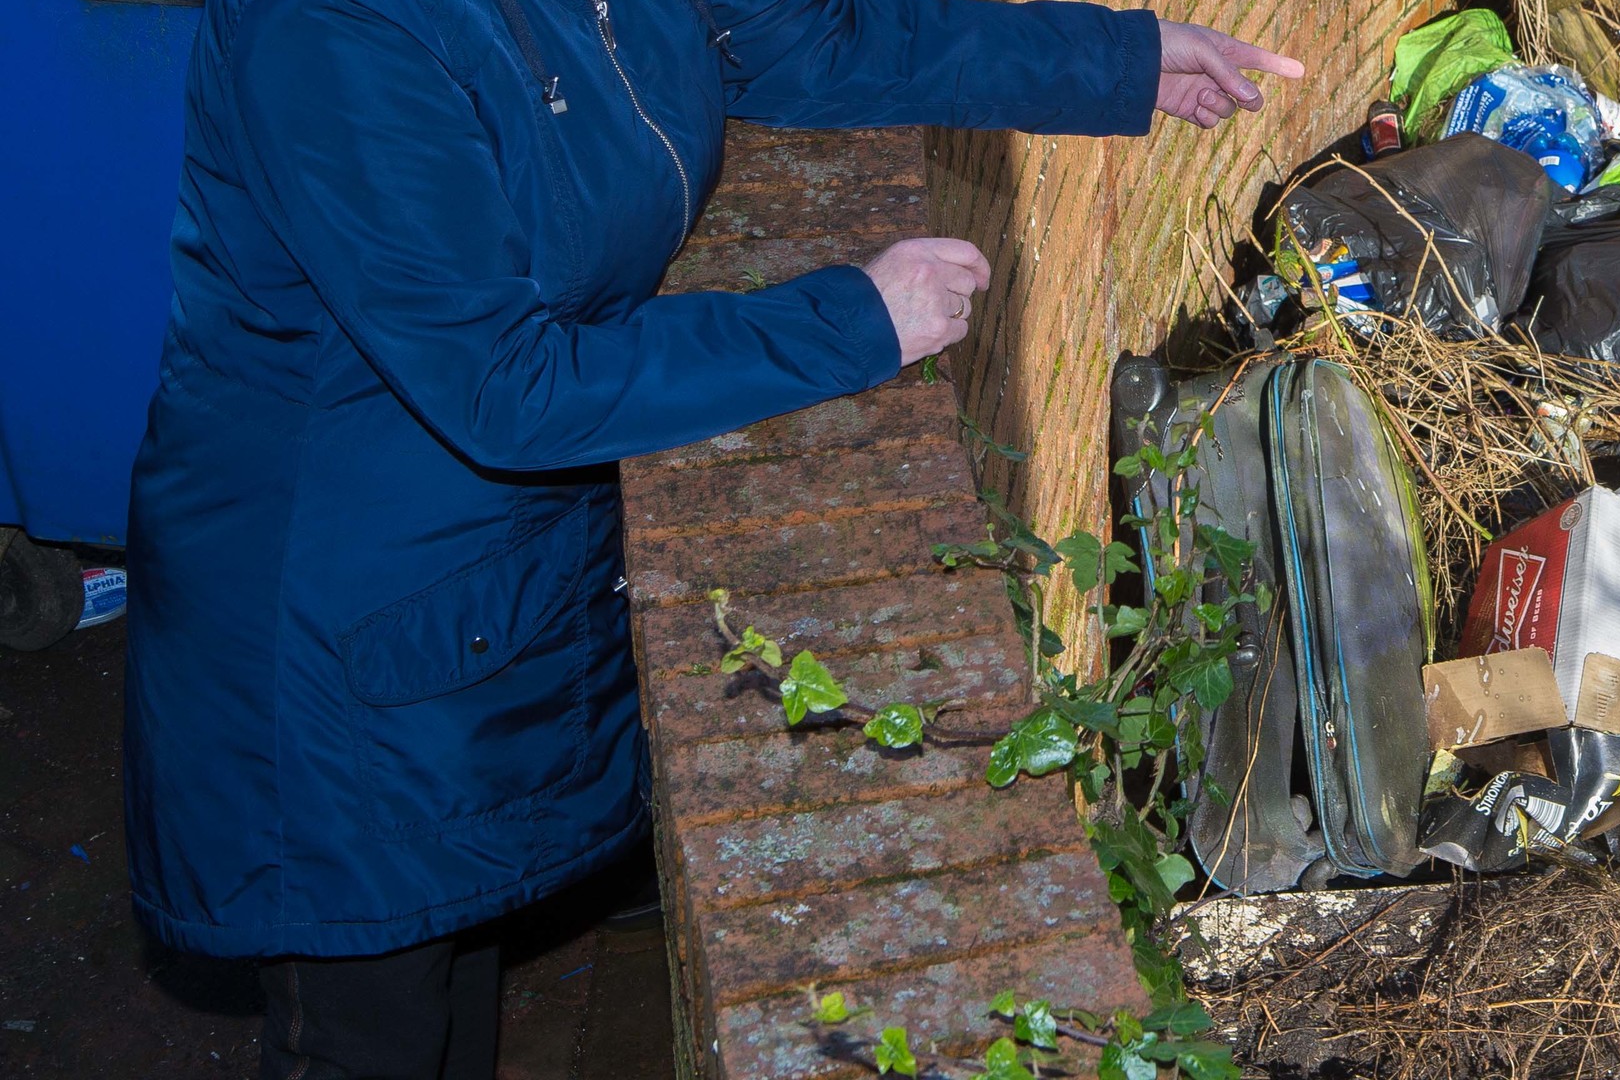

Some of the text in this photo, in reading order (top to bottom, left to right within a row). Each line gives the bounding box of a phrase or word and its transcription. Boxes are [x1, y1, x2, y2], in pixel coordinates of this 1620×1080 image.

[83, 575, 126, 591] LPHIA
[1495, 545, 1528, 650] dweiser
[1532, 589, 1543, 623] BEERS
[1530, 627, 1537, 639] OF
[1475, 770, 1511, 816] STRONGB
